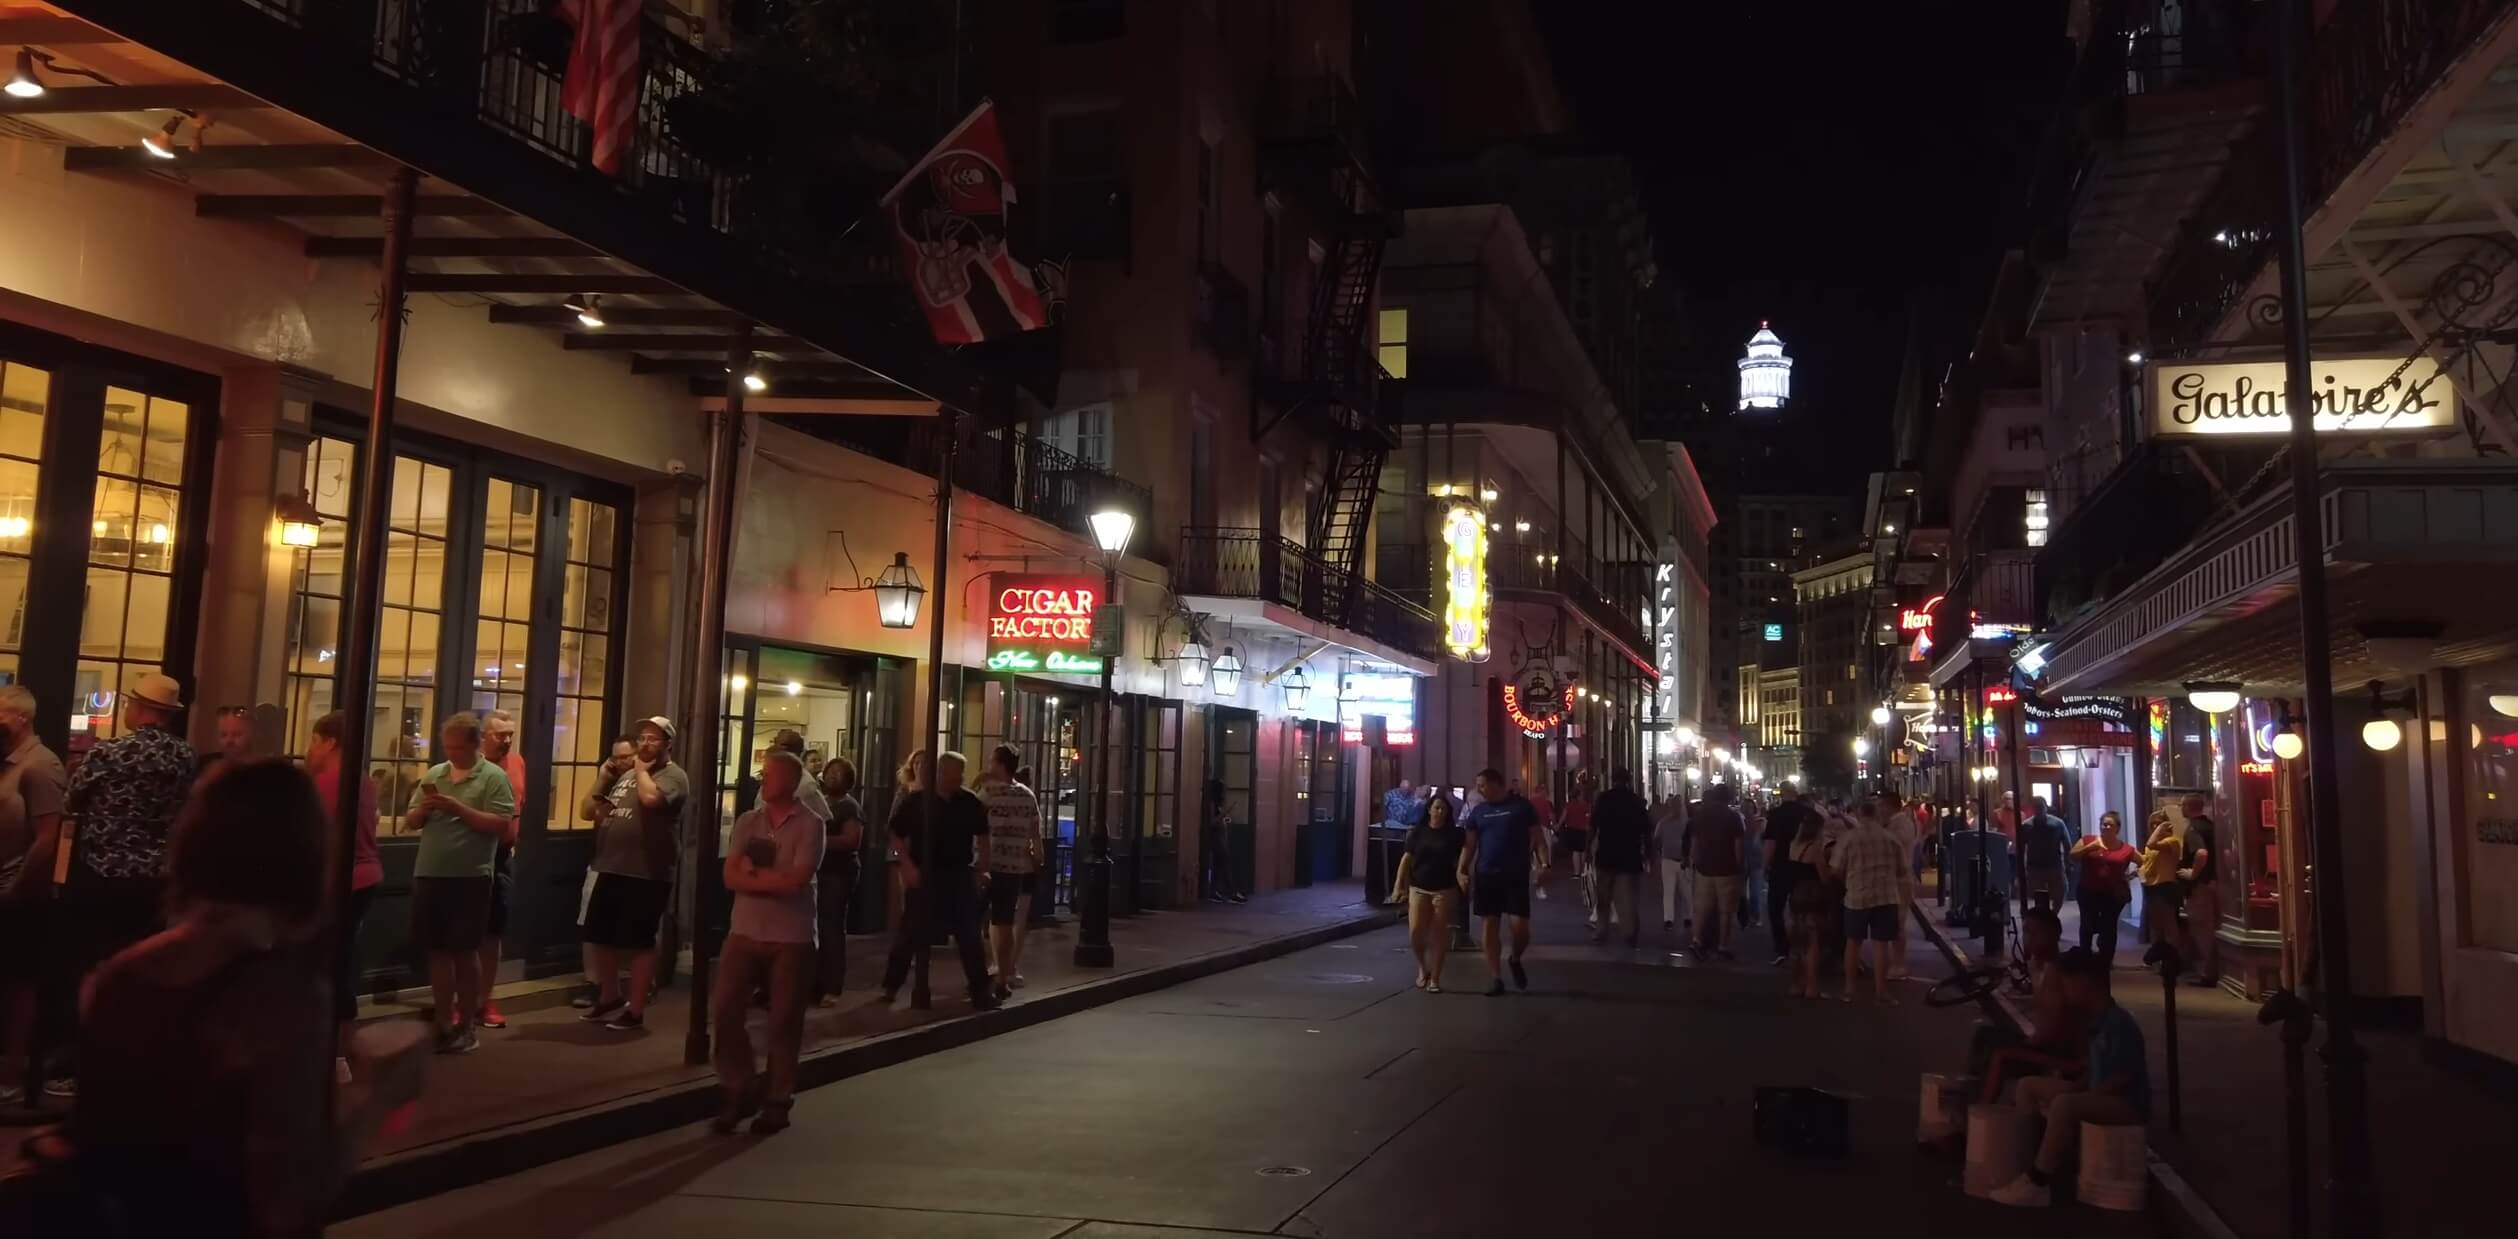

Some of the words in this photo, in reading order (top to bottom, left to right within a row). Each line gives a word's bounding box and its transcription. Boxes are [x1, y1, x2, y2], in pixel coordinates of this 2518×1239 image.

[1000, 588, 1093, 616] CIGAR
[990, 617, 1091, 639] FACTOR
[1656, 563, 1675, 714] Krystal
[1504, 684, 1546, 731] BOURBON
